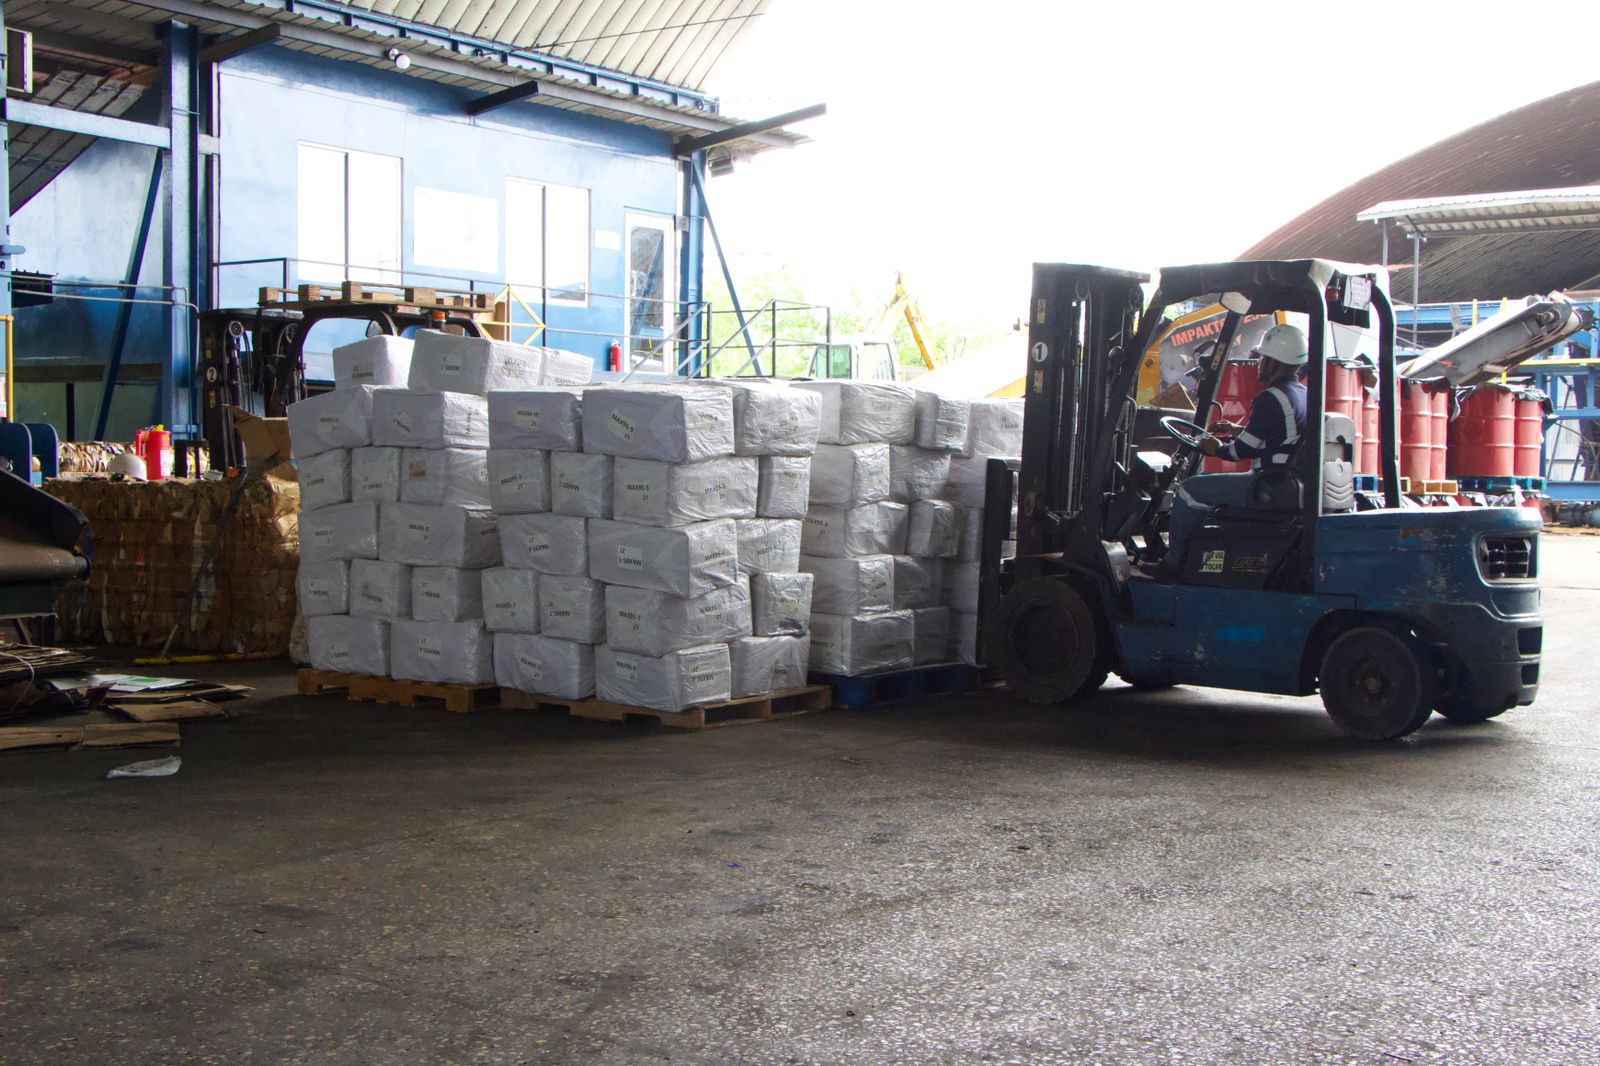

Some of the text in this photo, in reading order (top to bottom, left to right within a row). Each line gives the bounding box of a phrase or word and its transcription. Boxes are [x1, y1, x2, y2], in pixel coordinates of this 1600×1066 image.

[1170, 317, 1225, 347] IMPAKT
[1036, 344, 1042, 360] 1
[209, 369, 215, 380] 2
